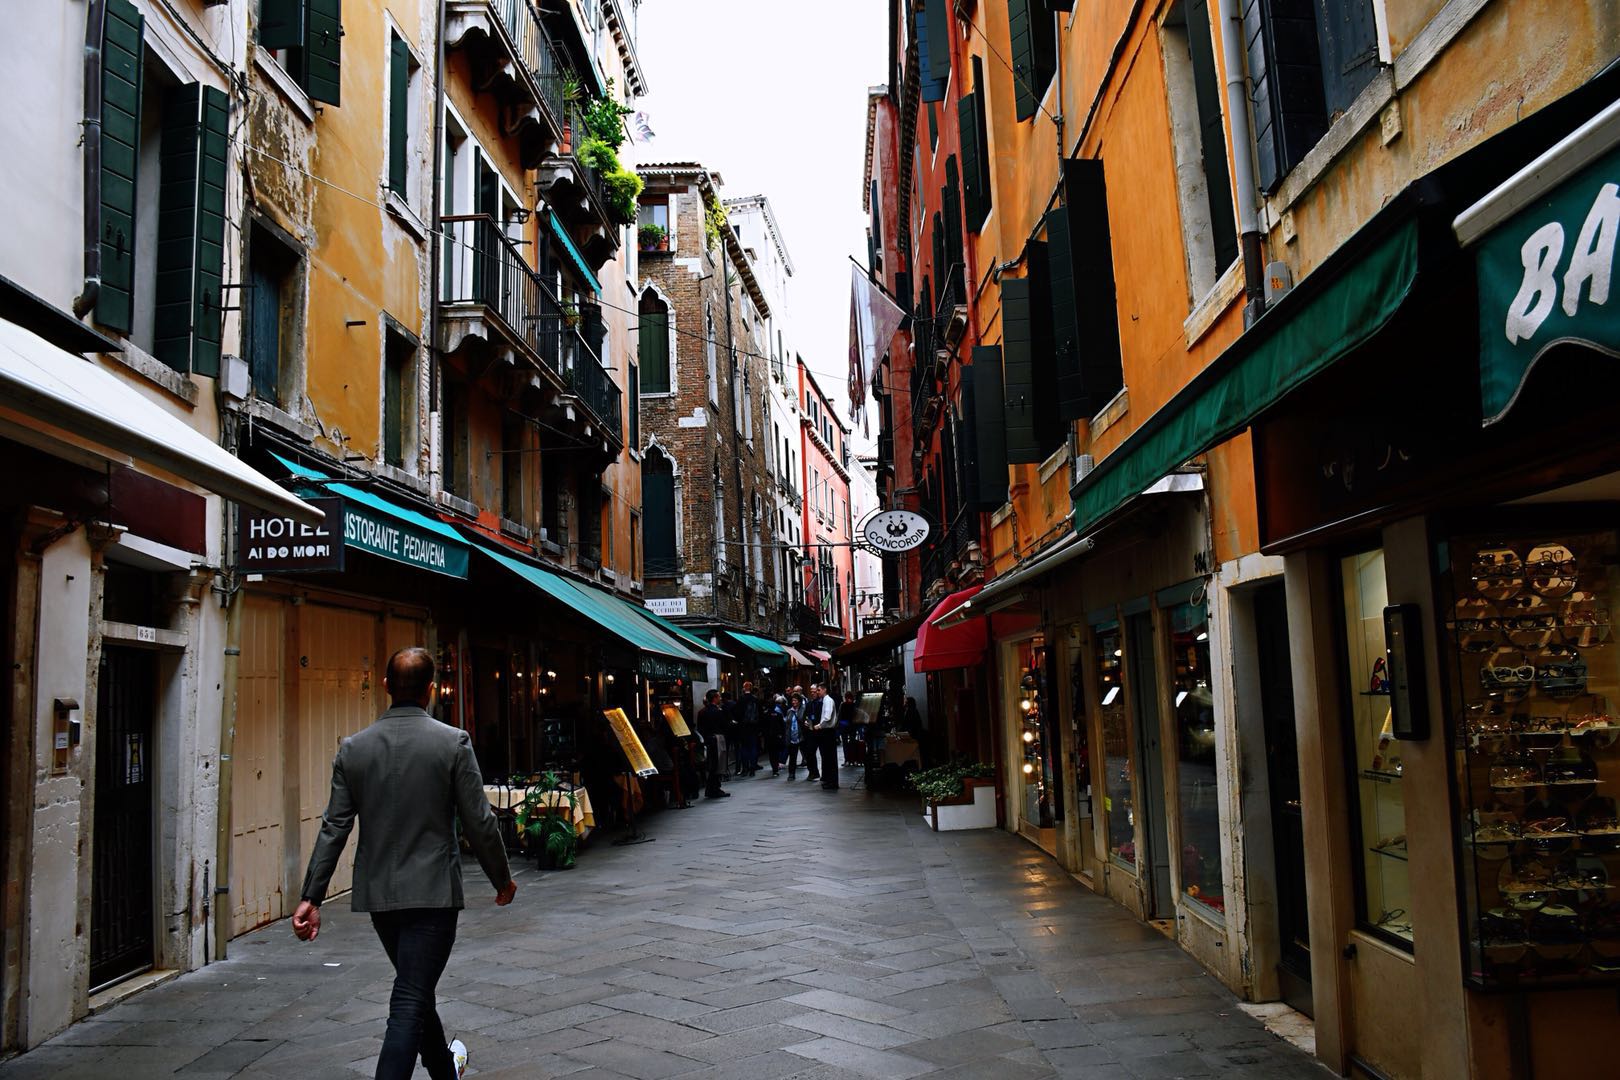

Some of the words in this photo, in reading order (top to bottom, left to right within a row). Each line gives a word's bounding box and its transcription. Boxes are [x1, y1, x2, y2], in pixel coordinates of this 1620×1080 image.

[869, 528, 926, 549] CONCORDIA
[248, 547, 262, 559] AI
[267, 546, 289, 559] DO
[293, 545, 330, 558] MORI
[403, 534, 446, 568] PEDAVENA
